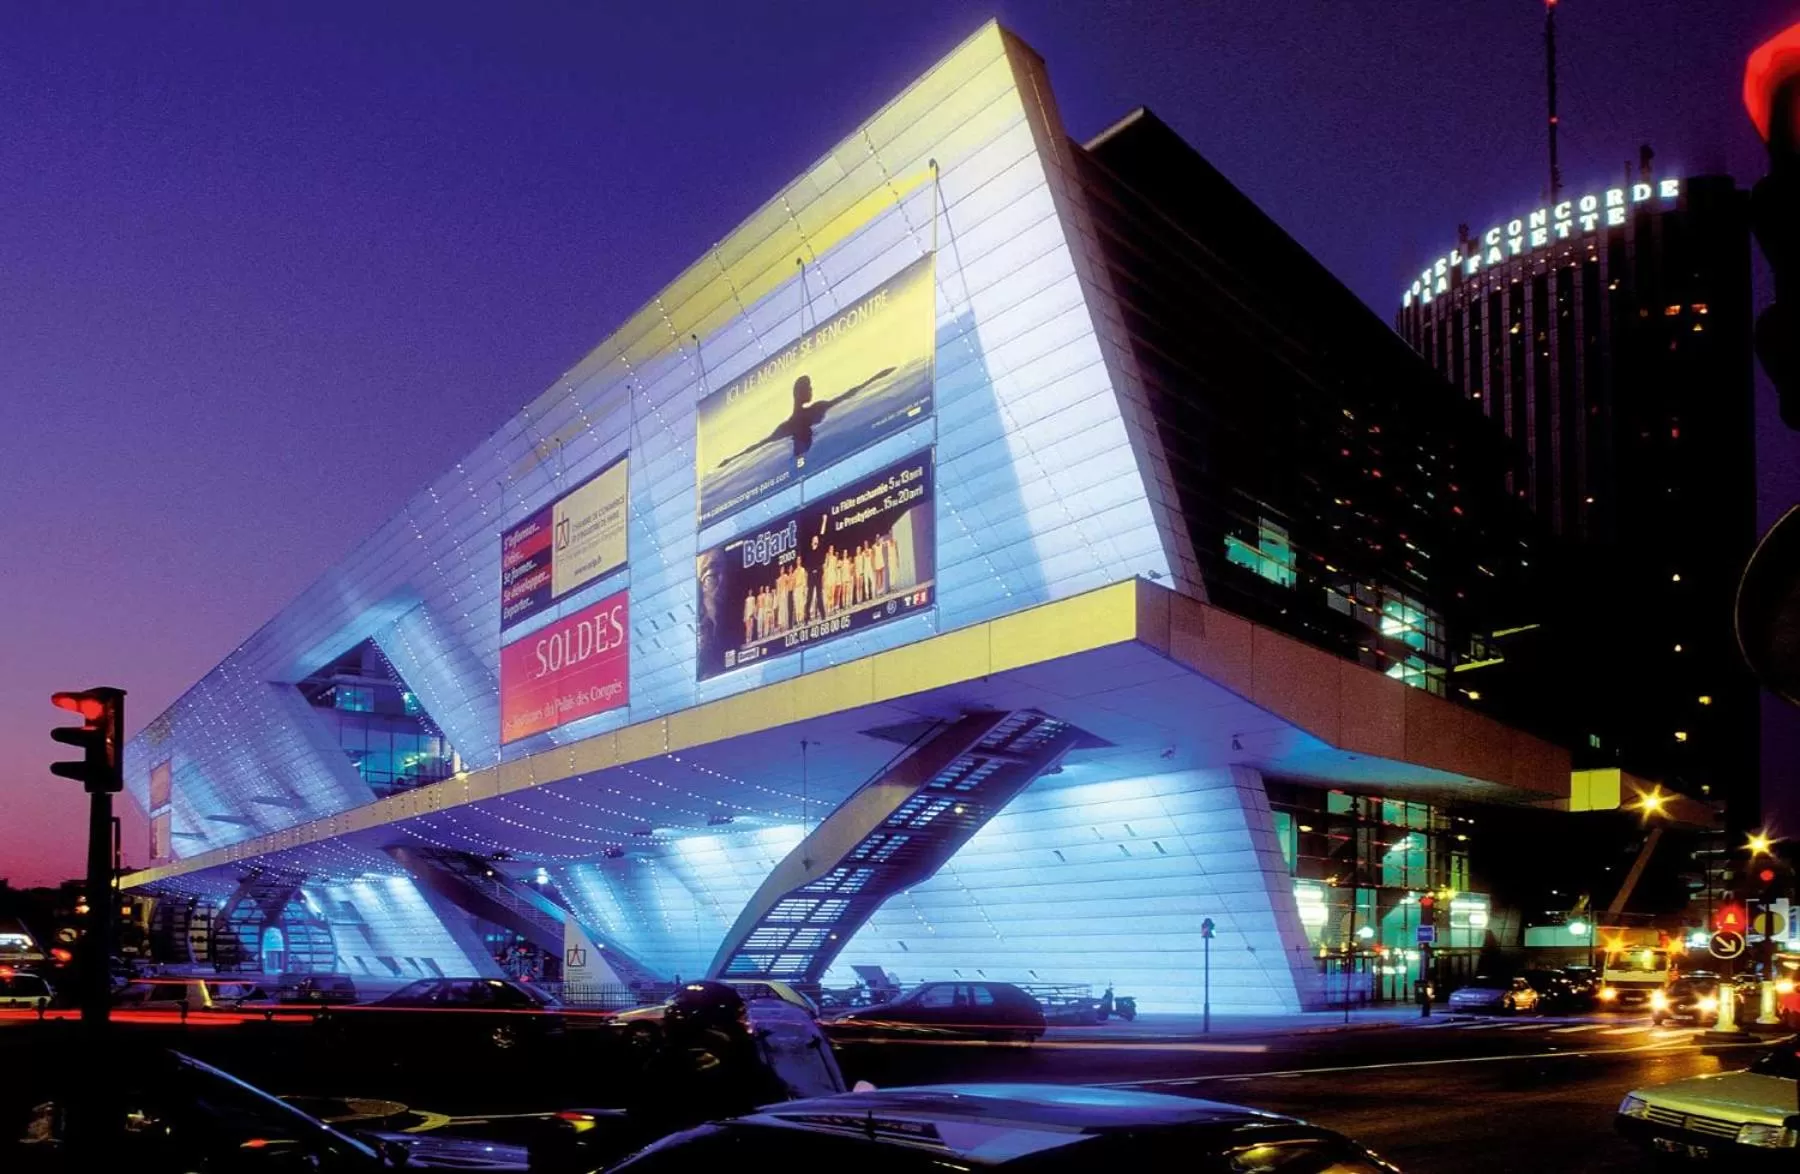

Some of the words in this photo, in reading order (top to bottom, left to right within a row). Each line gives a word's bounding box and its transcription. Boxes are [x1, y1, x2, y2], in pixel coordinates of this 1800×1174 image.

[1403, 249, 1463, 307] HOTEL
[1486, 179, 1679, 245] CONCORDE
[1422, 277, 1447, 304] LA
[1466, 207, 1625, 274] FAYETTE
[744, 375, 756, 394] LE
[757, 346, 798, 386] MONDE
[800, 336, 813, 358] SE
[815, 289, 888, 348] RENCONTRE
[884, 495, 892, 509] 15
[898, 488, 909, 504] 20
[889, 476, 895, 490] 5
[901, 469, 909, 483] 13
[743, 520, 798, 569] Béjart
[536, 604, 624, 678] SOLDES
[590, 678, 624, 702] Congrès
